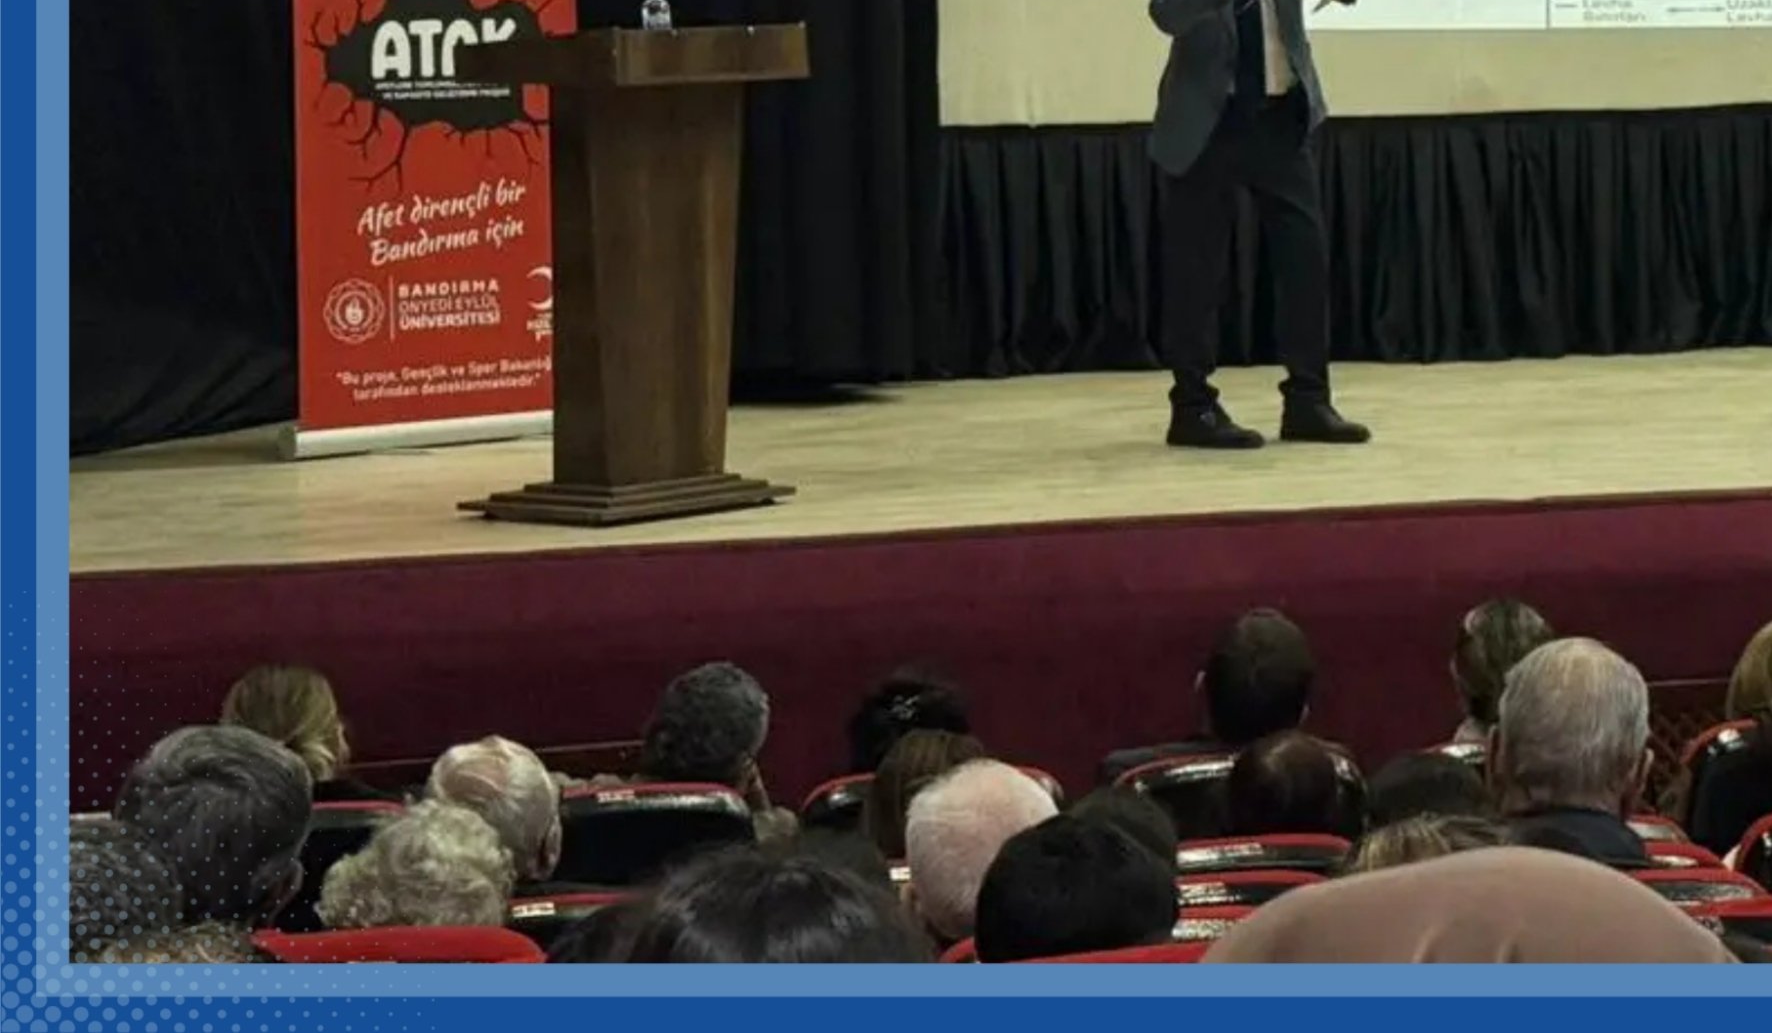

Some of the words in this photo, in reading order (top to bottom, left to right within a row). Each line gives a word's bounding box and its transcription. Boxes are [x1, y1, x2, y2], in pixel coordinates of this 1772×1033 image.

[357, 202, 404, 237] Afet
[410, 181, 490, 224] dirençli
[495, 177, 526, 204] bir
[370, 228, 480, 266] Bandırma
[485, 216, 525, 247] için
[398, 278, 500, 299] BANDIRMA
